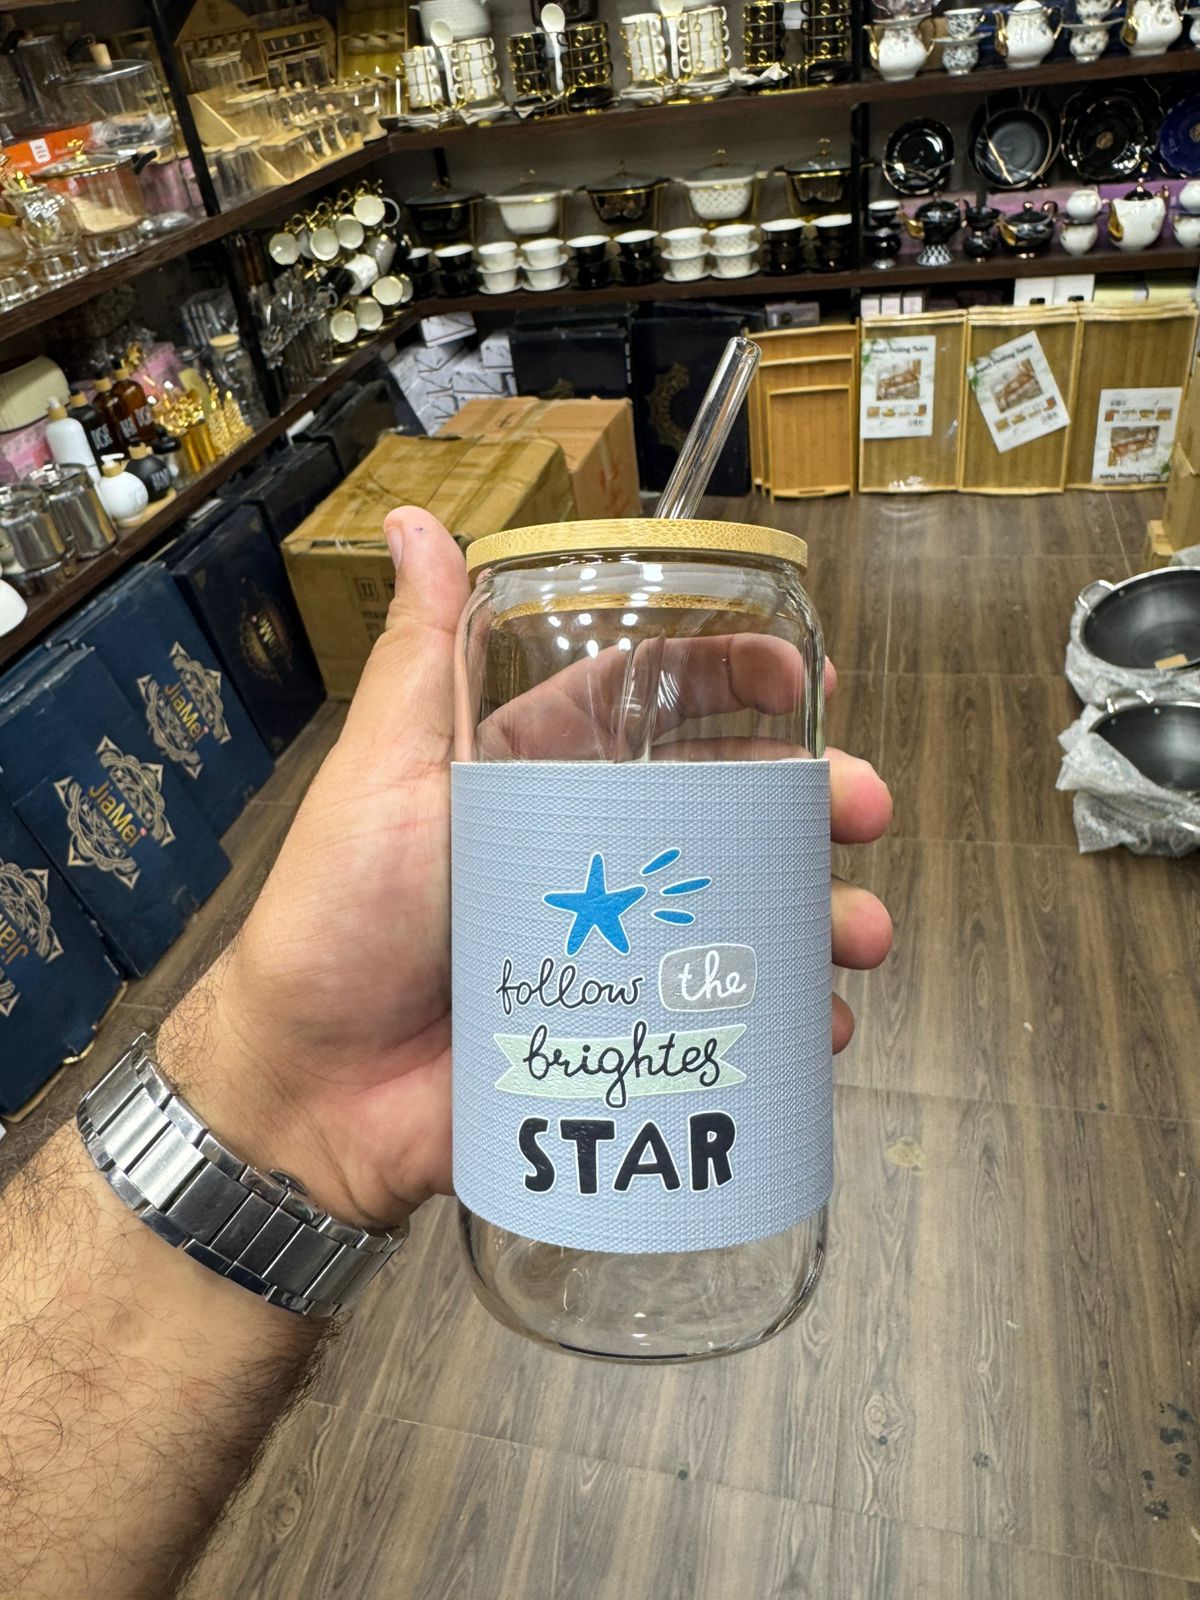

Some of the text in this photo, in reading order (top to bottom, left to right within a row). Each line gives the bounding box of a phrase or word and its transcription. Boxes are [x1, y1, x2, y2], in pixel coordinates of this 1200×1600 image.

[163, 681, 209, 743] JiaMei
[88, 780, 147, 848] JiaMei
[496, 949, 748, 1016] follow the
[517, 1111, 737, 1195] STAR
